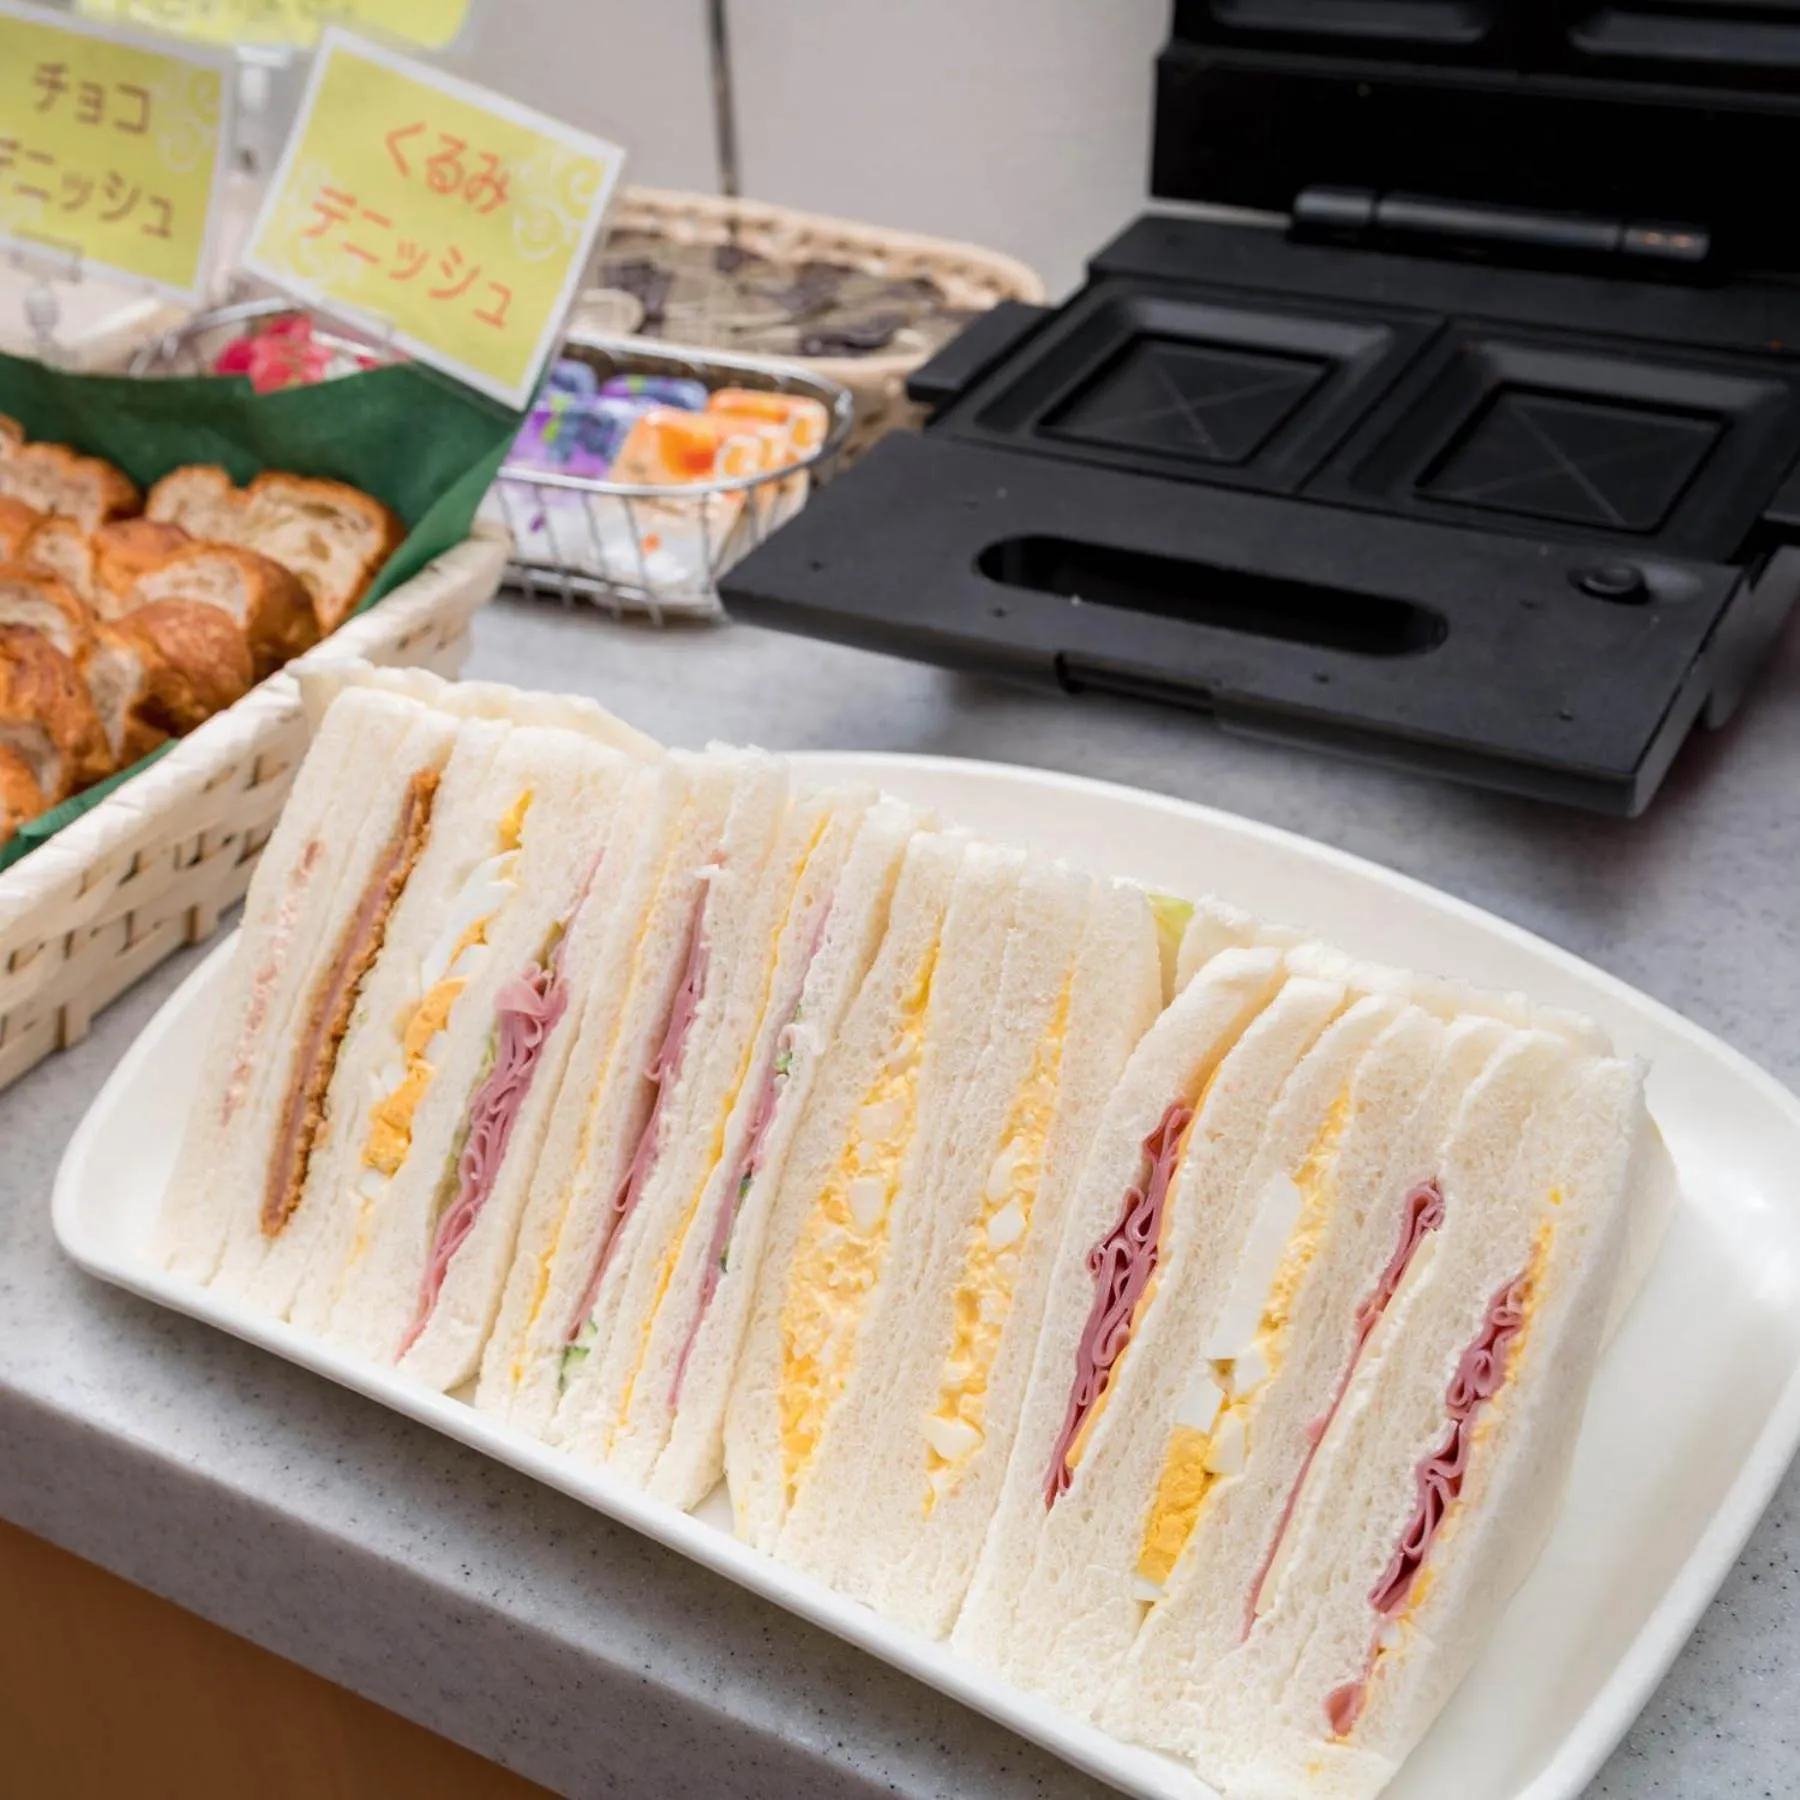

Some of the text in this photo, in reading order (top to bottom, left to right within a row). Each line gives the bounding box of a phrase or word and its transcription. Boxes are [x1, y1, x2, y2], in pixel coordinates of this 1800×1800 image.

[33, 62, 151, 134] チョコ
[385, 121, 510, 215] くるみ
[303, 186, 511, 329] デニッシュ
